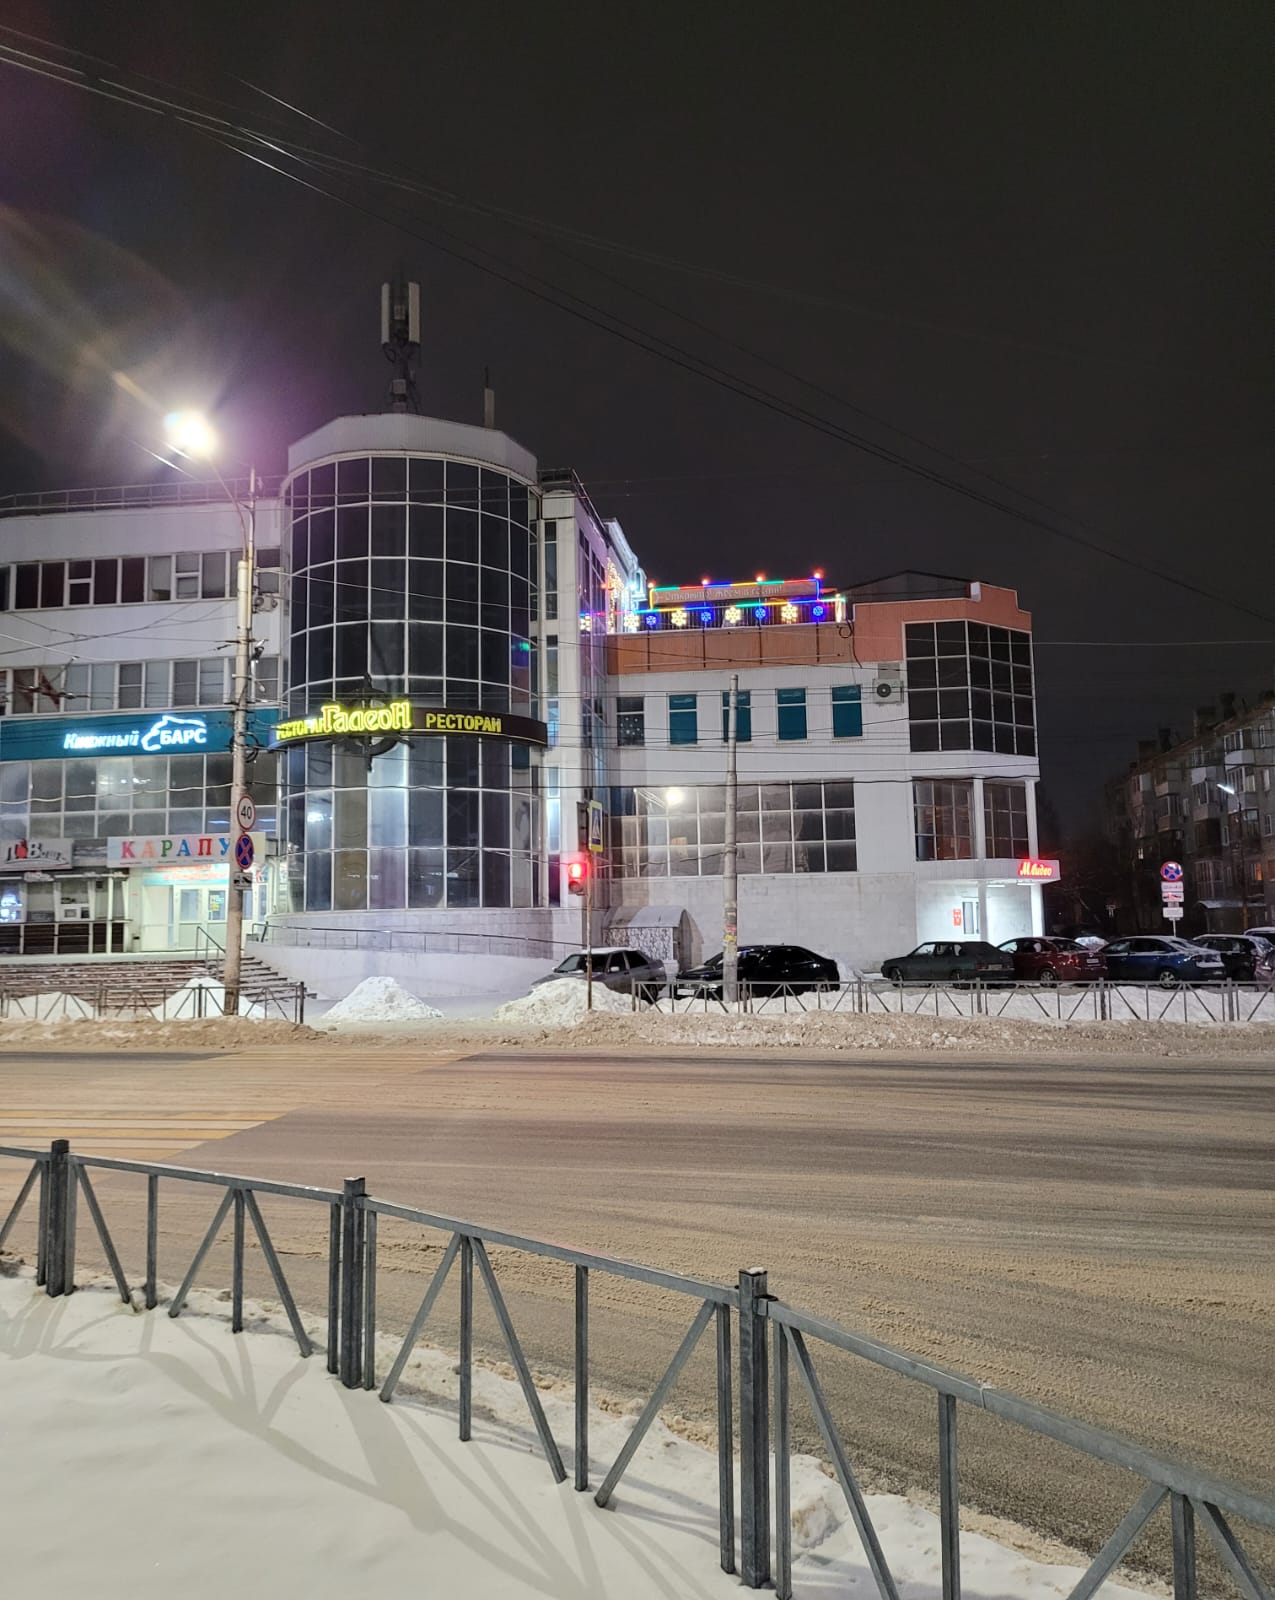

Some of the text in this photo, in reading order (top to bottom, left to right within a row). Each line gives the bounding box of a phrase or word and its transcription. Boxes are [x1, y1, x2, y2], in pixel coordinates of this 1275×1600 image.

[425, 713, 503, 733] РЕСТОРАН
[63, 728, 207, 749] Книжный БАРС
[240, 805, 253, 820] 40
[121, 839, 231, 858] КАРАПУ
